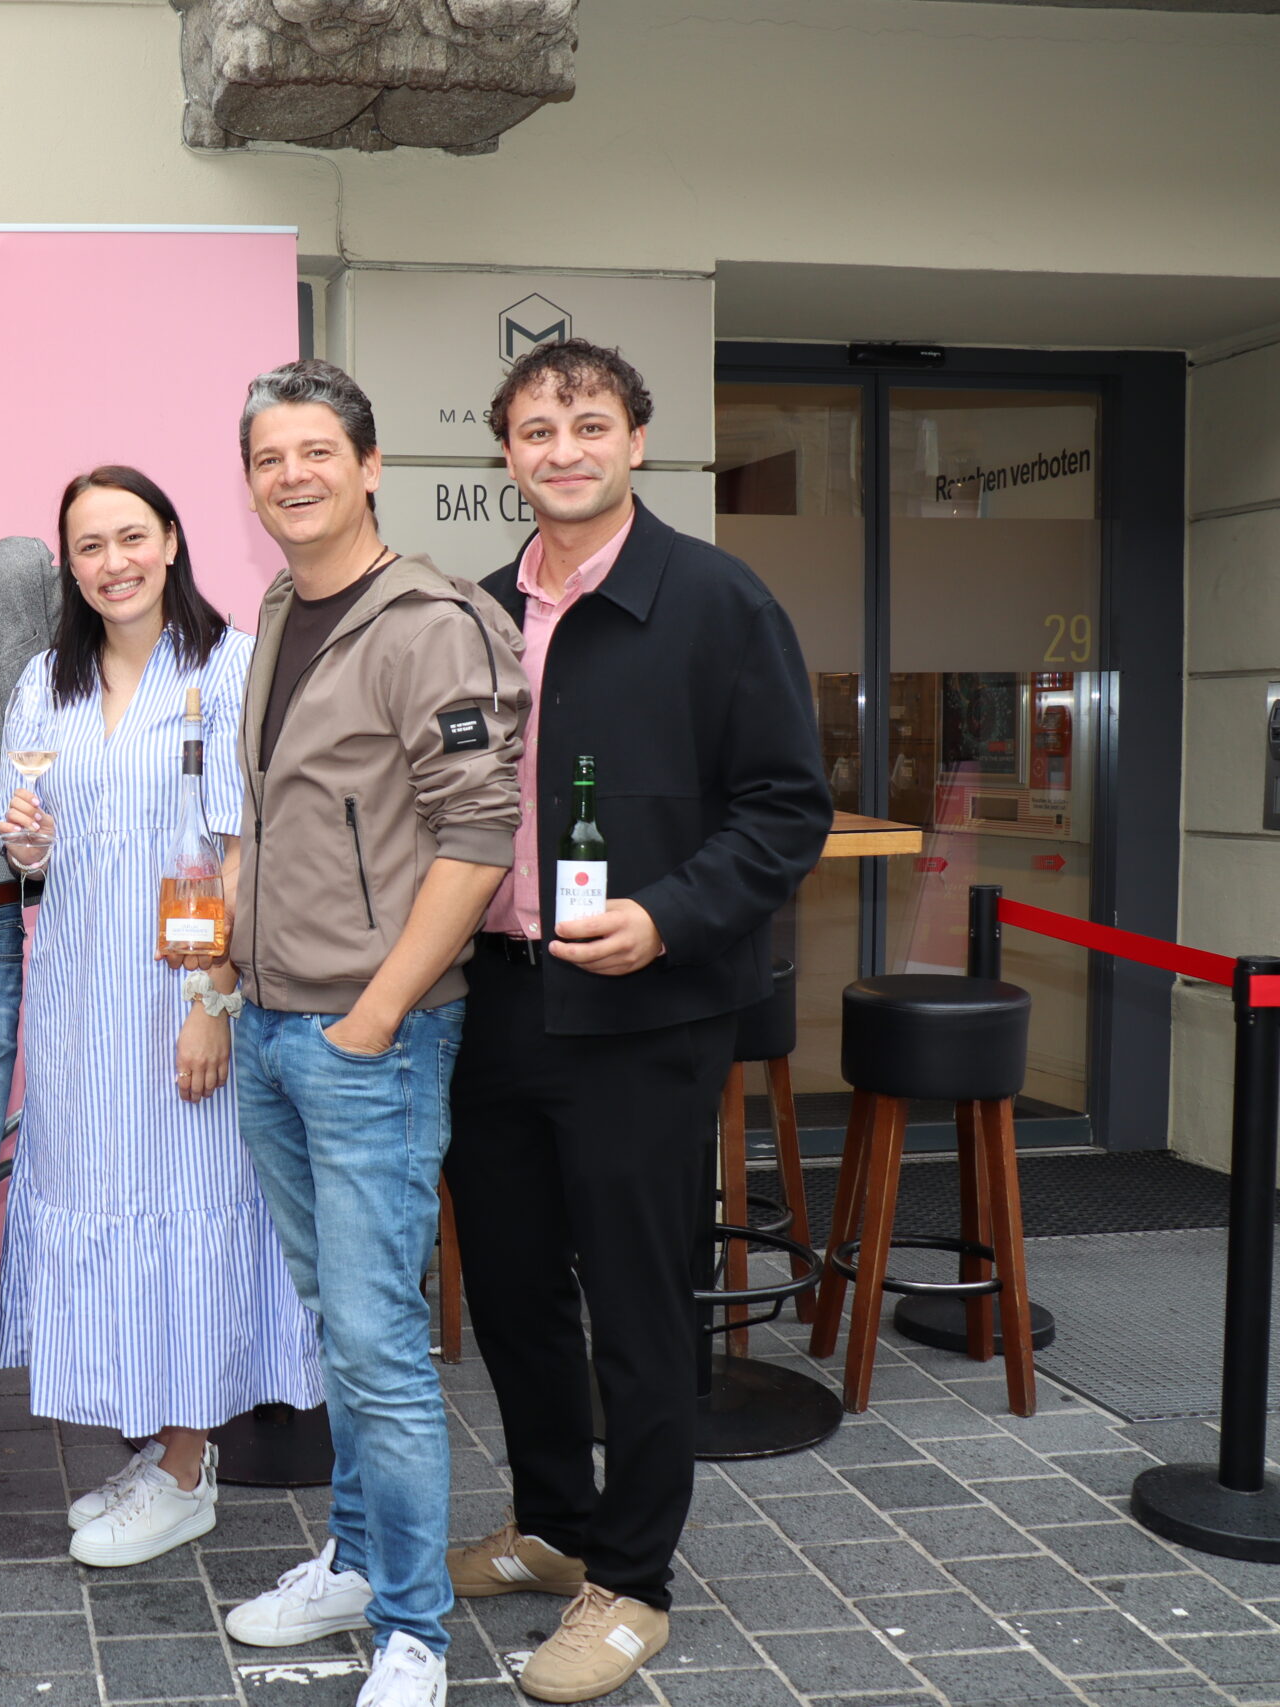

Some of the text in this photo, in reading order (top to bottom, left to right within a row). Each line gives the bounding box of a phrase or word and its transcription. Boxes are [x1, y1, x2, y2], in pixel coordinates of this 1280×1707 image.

[438, 408, 494, 425] MAS
[935, 447, 1091, 502] Rhen verboten
[436, 484, 490, 522] BAR
[1043, 613, 1092, 663] 29
[406, 1646, 427, 1663] FILA
